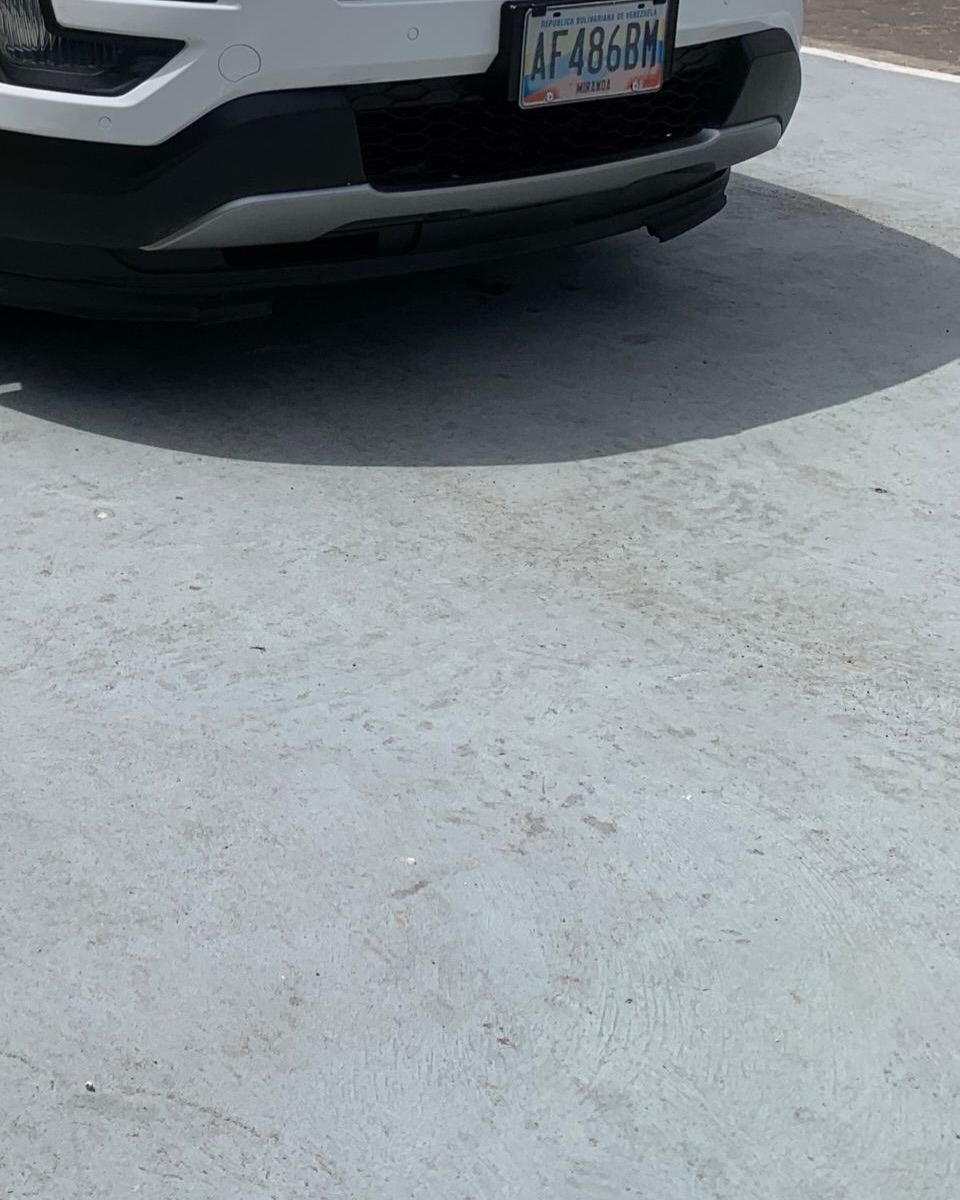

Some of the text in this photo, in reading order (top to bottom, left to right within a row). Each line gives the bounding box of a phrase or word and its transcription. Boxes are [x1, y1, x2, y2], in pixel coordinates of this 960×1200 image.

[616, 12, 624, 20] DE
[530, 19, 660, 81] AF486BM
[576, 80, 611, 94] MIRANDA
